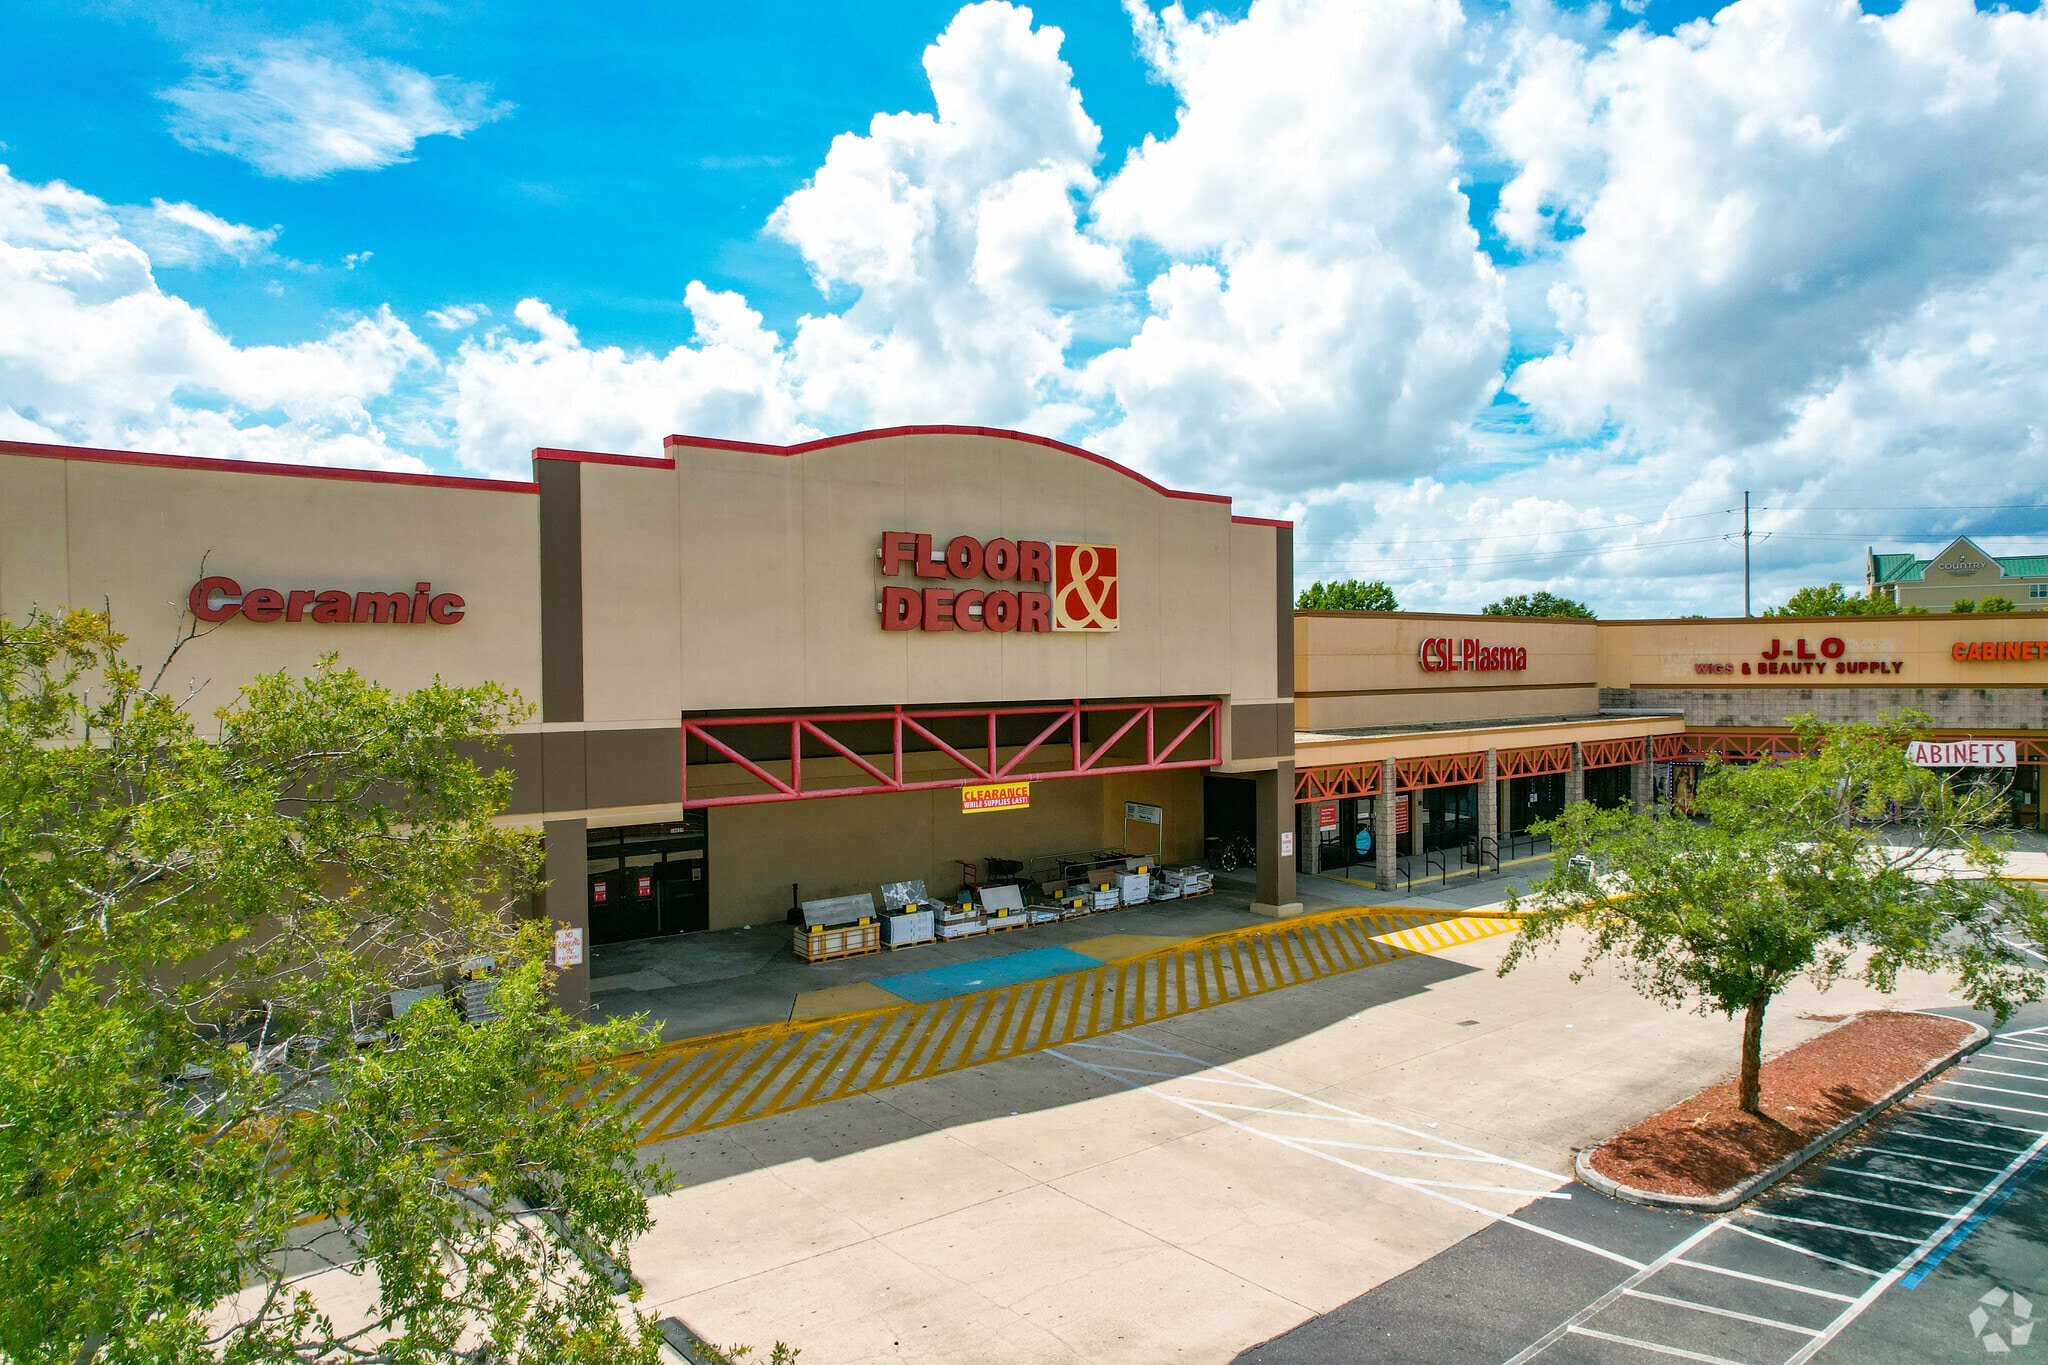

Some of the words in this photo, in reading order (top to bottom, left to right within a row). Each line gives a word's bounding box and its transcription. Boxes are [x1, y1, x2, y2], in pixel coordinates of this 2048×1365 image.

[882, 531, 1051, 582] FLOOR
[1055, 545, 1118, 629] &
[189, 576, 466, 625] Ceramic
[881, 586, 1051, 632] DECOR
[1420, 637, 1458, 672] CSL
[1461, 638, 1527, 671] Plasma
[1762, 637, 1846, 660] J-LO
[1952, 641, 2048, 661] CABINET
[1695, 663, 1734, 674] WIGS
[1741, 662, 1752, 675] &
[1757, 662, 1826, 675] BEAUTY
[1836, 661, 1903, 675] SUPPLY
[1915, 744, 2006, 764] ABINETS
[964, 786, 1028, 801] CLEARANCE
[964, 801, 983, 809] WHILE
[984, 798, 1010, 807] SUPPLIES
